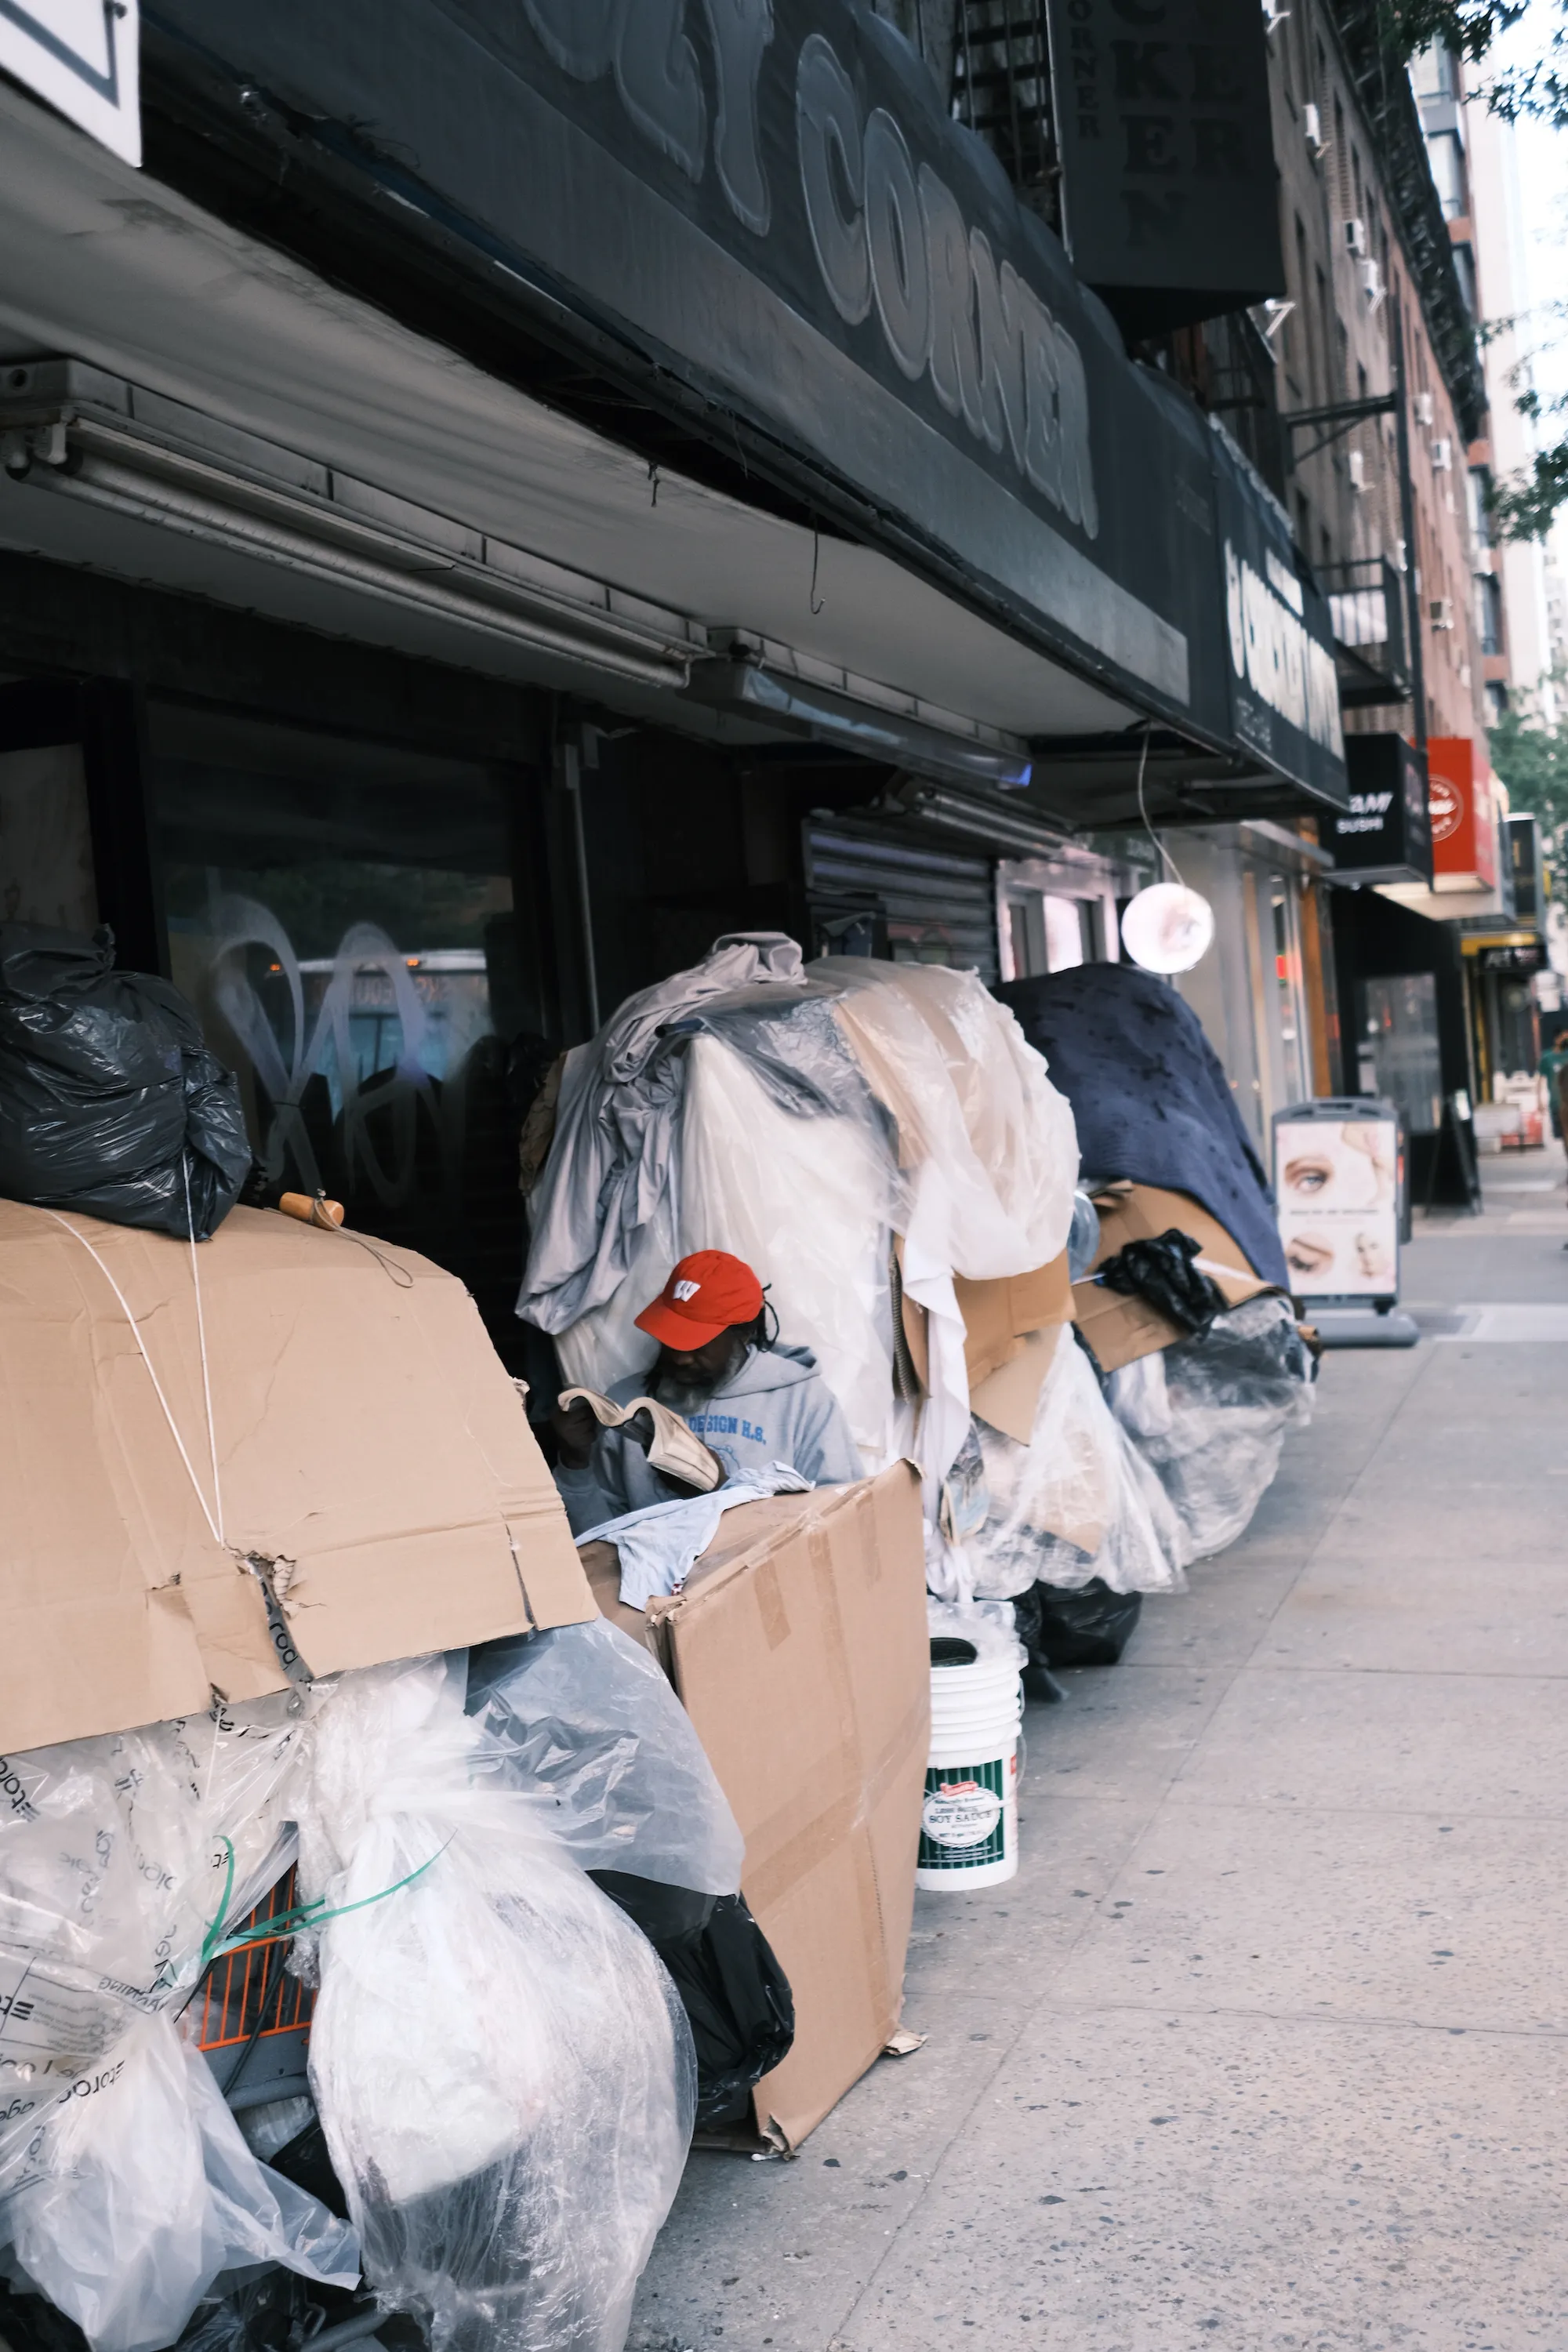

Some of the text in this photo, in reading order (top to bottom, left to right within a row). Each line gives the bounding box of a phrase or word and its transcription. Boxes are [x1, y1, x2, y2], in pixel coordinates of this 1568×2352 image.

[1337, 817, 1385, 835] SUSHI
[673, 1280, 701, 1302] W
[688, 1414, 738, 1435] DESIGN
[929, 1813, 991, 1824] SOY SAUCE
